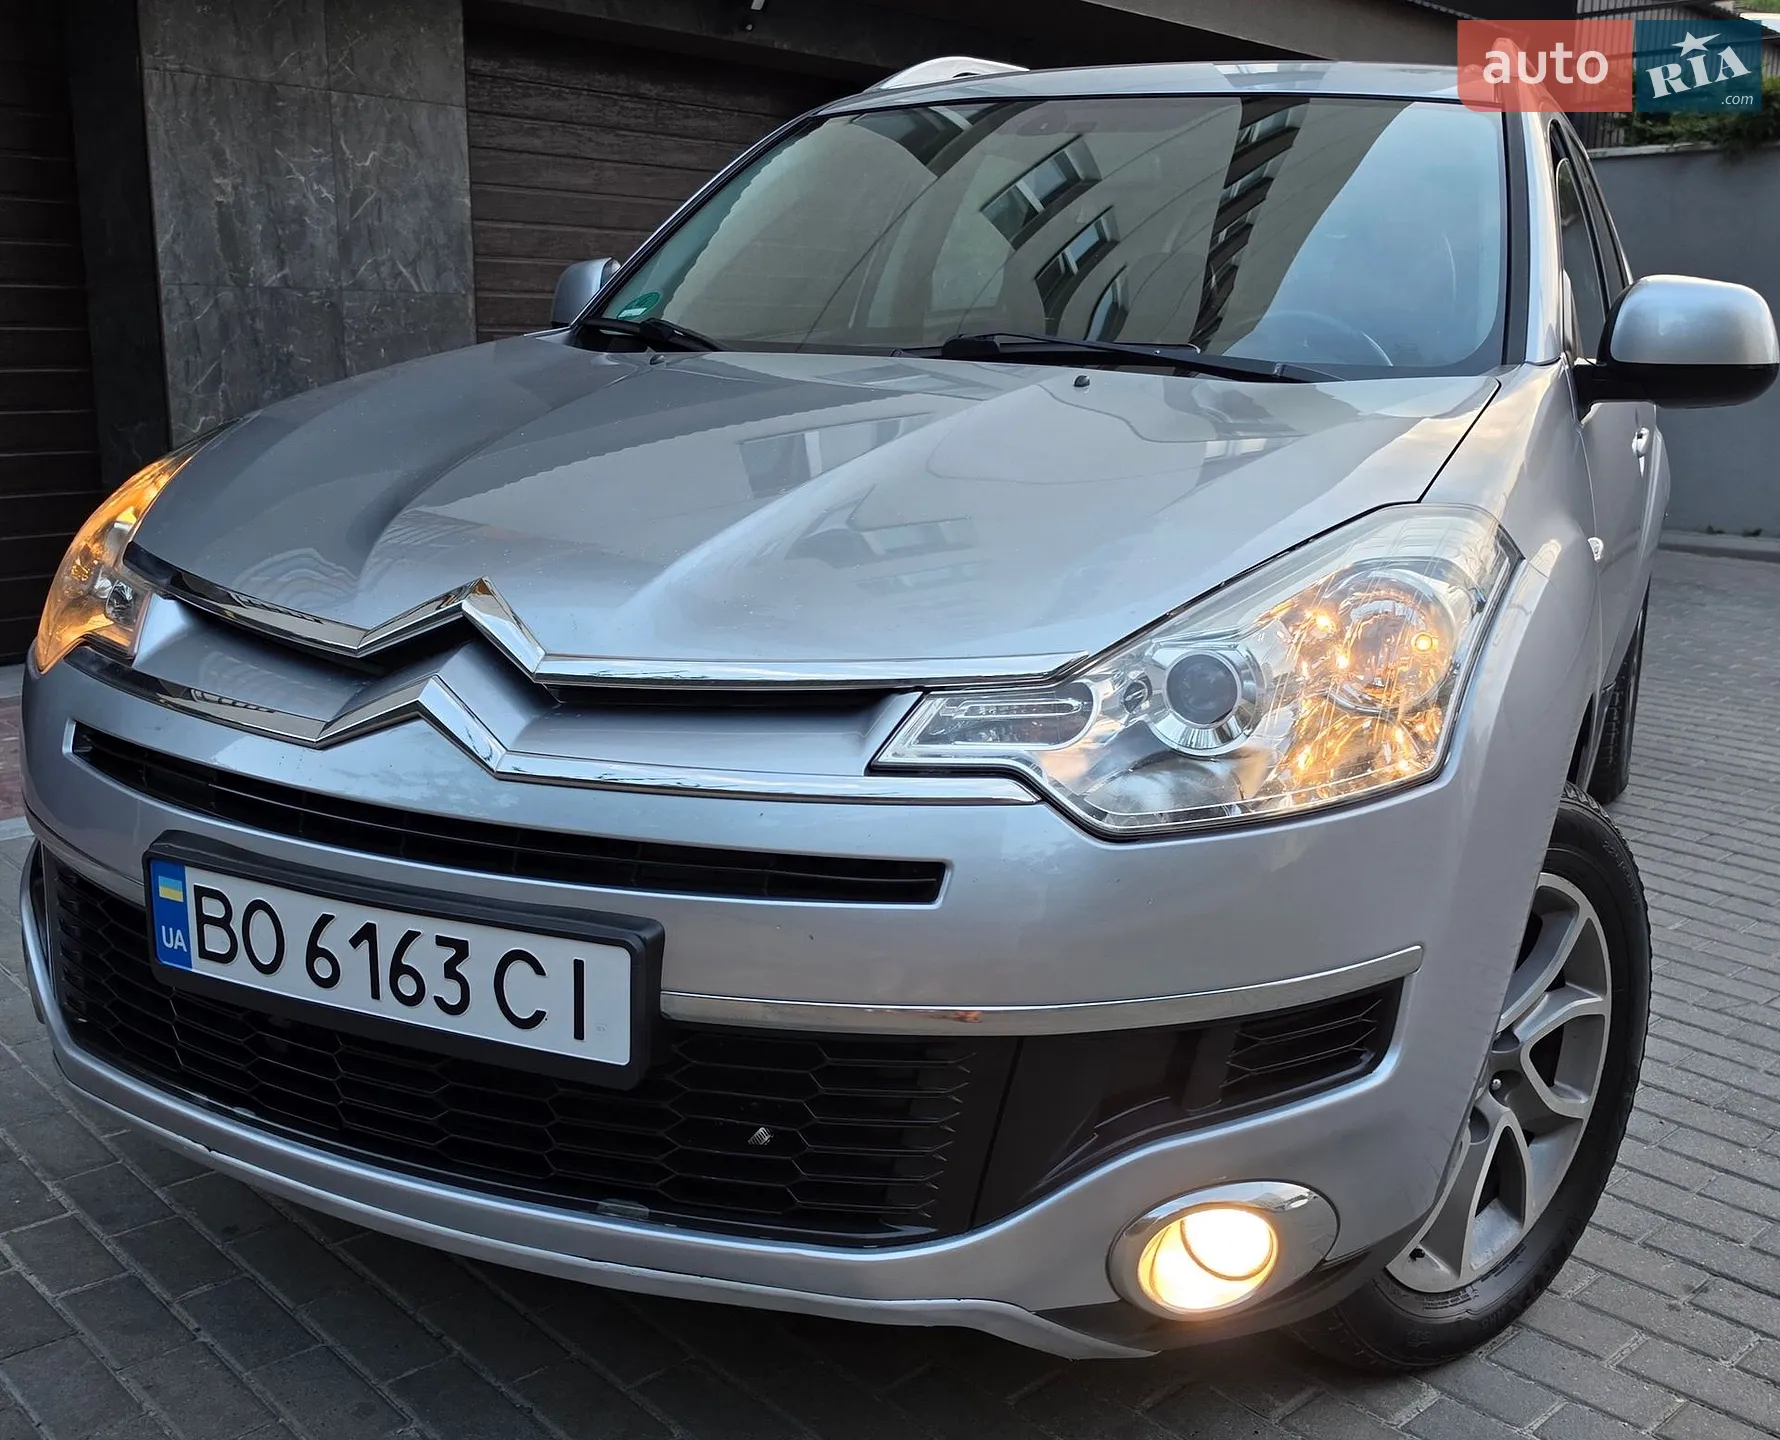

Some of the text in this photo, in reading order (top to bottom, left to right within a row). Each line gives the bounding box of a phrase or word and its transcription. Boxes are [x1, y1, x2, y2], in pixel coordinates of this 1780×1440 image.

[161, 926, 188, 953] UA
[193, 884, 585, 1041] BO 6163 CI
